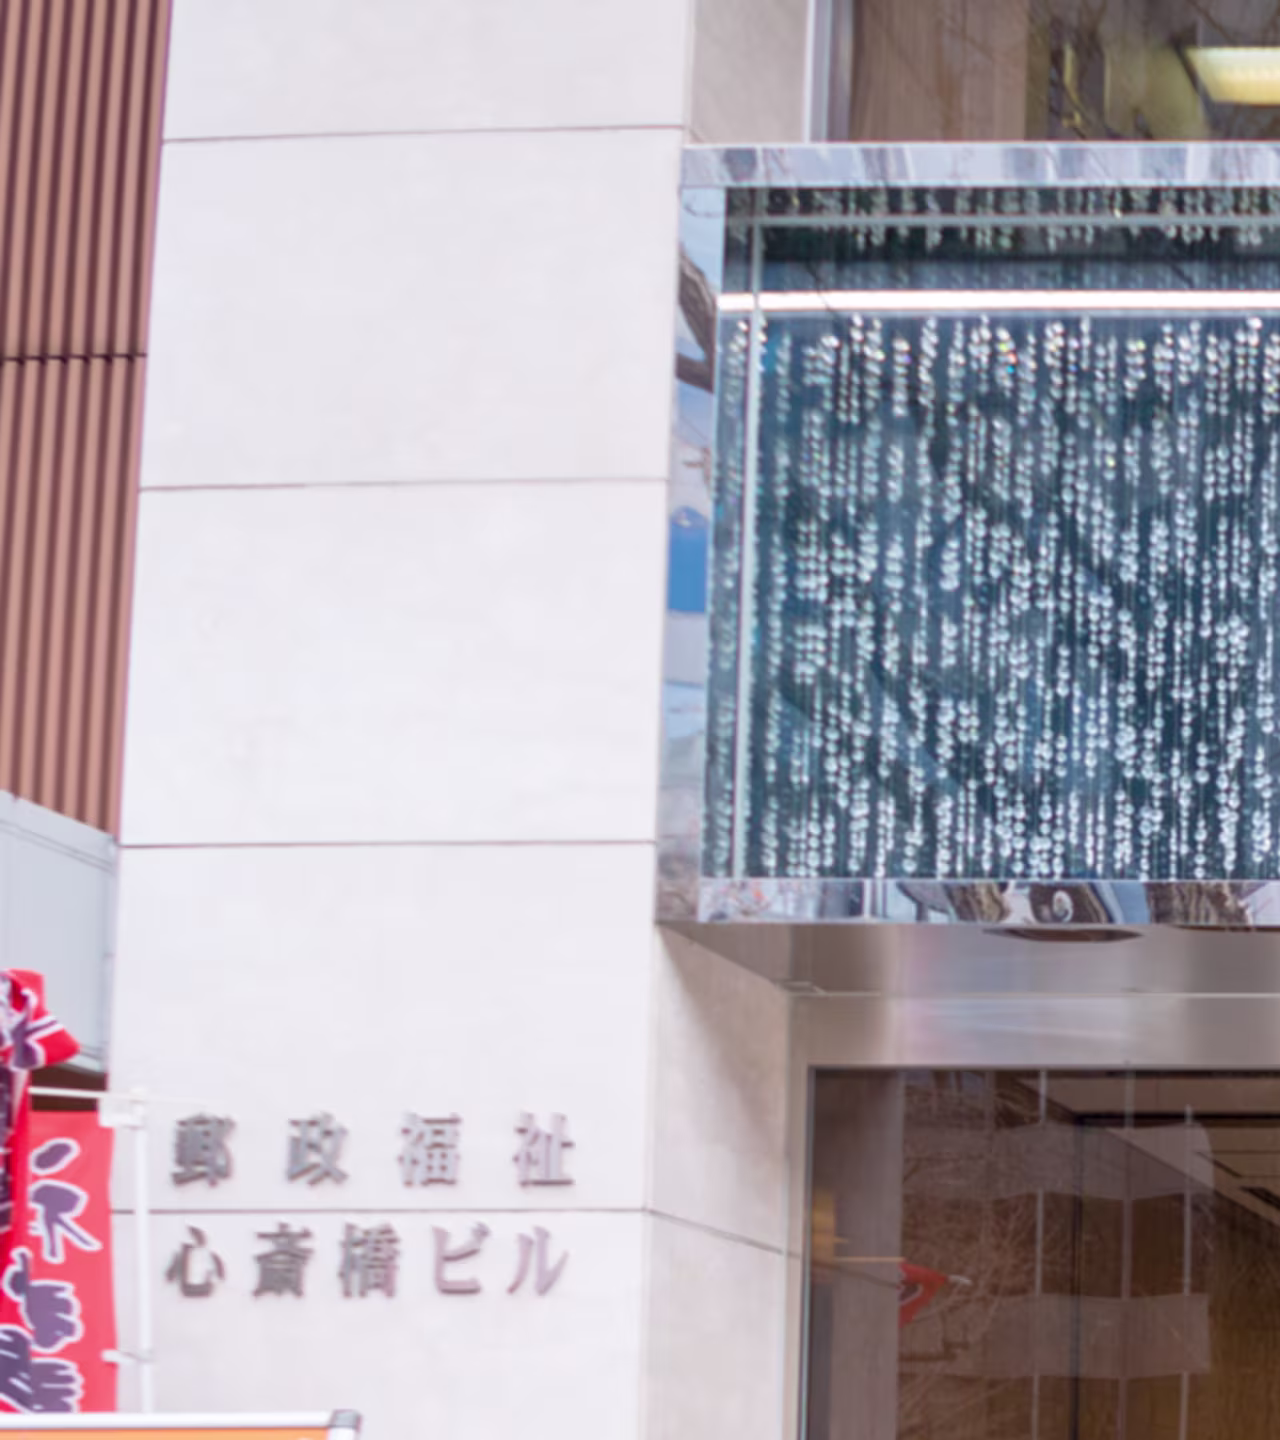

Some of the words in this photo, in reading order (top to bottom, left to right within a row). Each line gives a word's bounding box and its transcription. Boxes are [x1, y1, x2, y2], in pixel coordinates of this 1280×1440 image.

[170, 1110, 576, 1188] 郵政福祉
[166, 1221, 569, 1299] 心斎橋ビル
